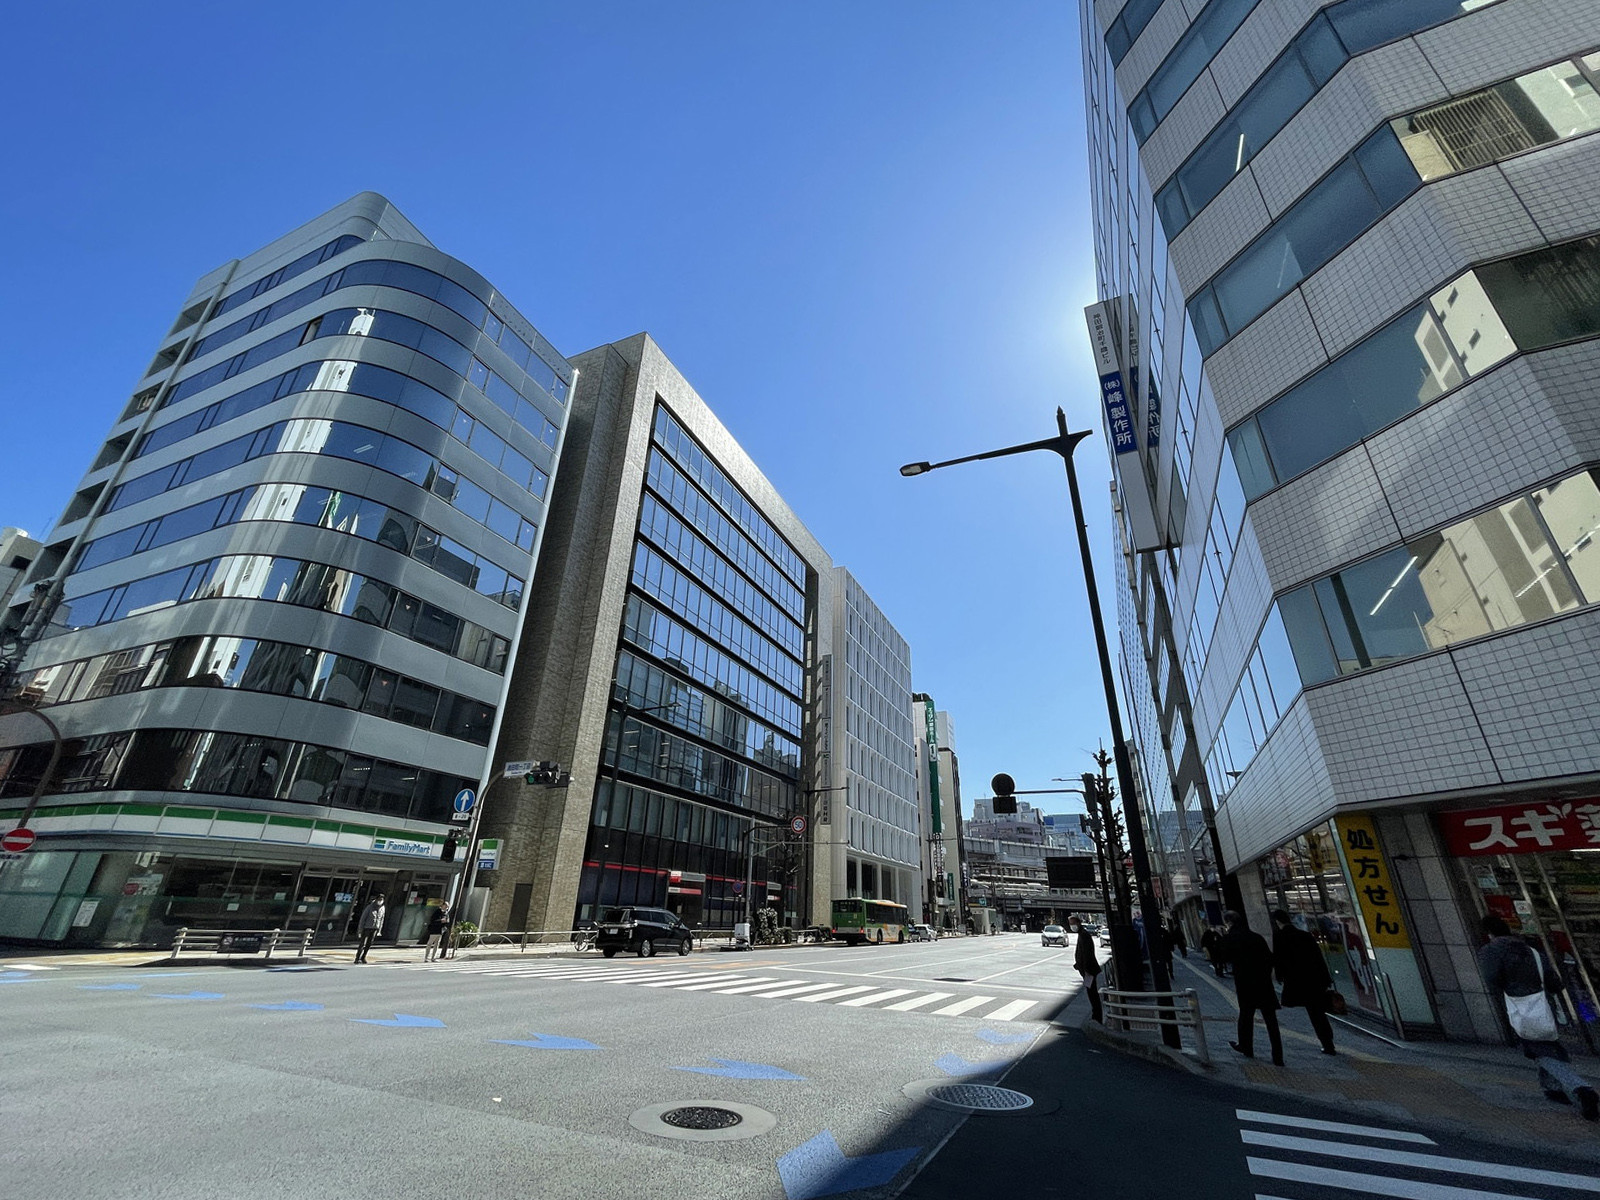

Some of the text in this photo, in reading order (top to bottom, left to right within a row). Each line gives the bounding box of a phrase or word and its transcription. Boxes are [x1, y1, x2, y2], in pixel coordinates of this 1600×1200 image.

[1104, 378, 1132, 447] (株)峰製作所
[795, 820, 804, 829] 50
[388, 840, 431, 854] FamilyMart
[1347, 828, 1401, 936] 処方せん
